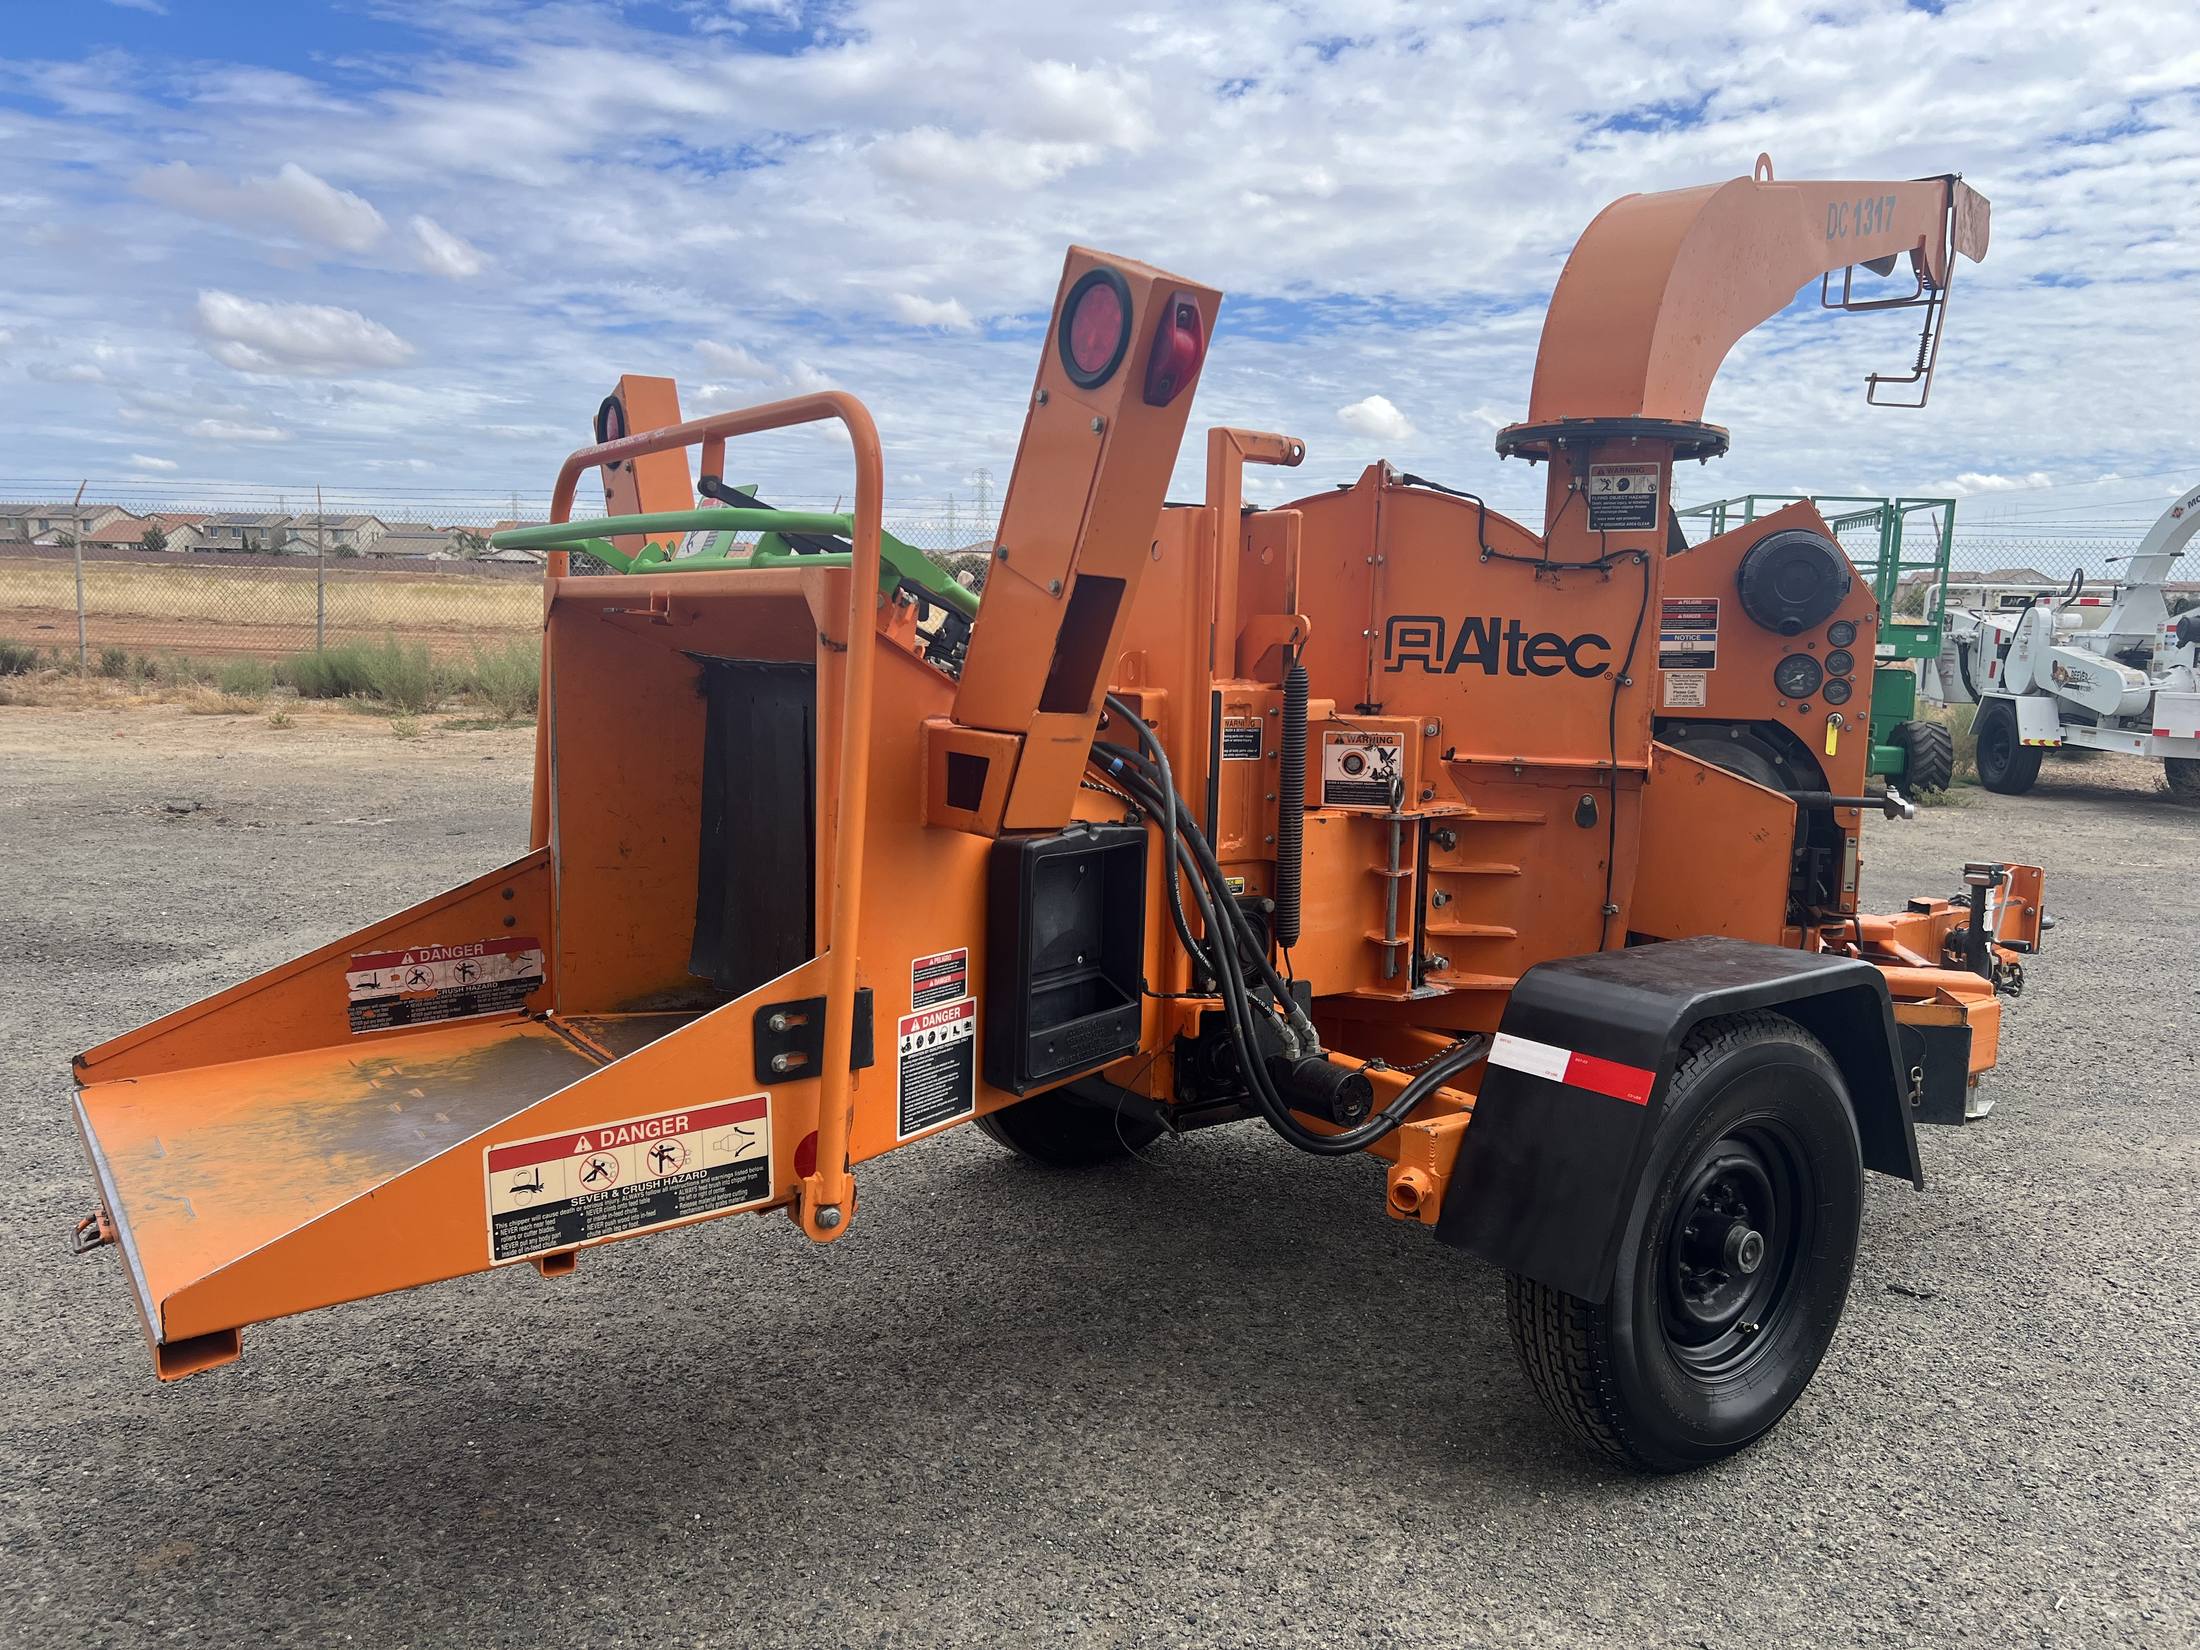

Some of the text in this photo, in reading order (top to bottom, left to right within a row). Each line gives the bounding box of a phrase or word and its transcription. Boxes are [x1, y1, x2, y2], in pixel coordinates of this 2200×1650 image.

[1826, 195, 1897, 240] DC 1317
[1444, 616, 1612, 678] Altec
[419, 944, 484, 962] DANGER
[436, 982, 498, 996] CRUSH HAZARD
[922, 1006, 961, 1028] DANGER
[600, 1114, 690, 1149] DANGER
[571, 1169, 708, 1207] SEVER & CRUSH HAZARD
[496, 1221, 508, 1230] This
[509, 1216, 530, 1229] chipper
[542, 1211, 558, 1220] cause
[560, 1206, 575, 1216] death
